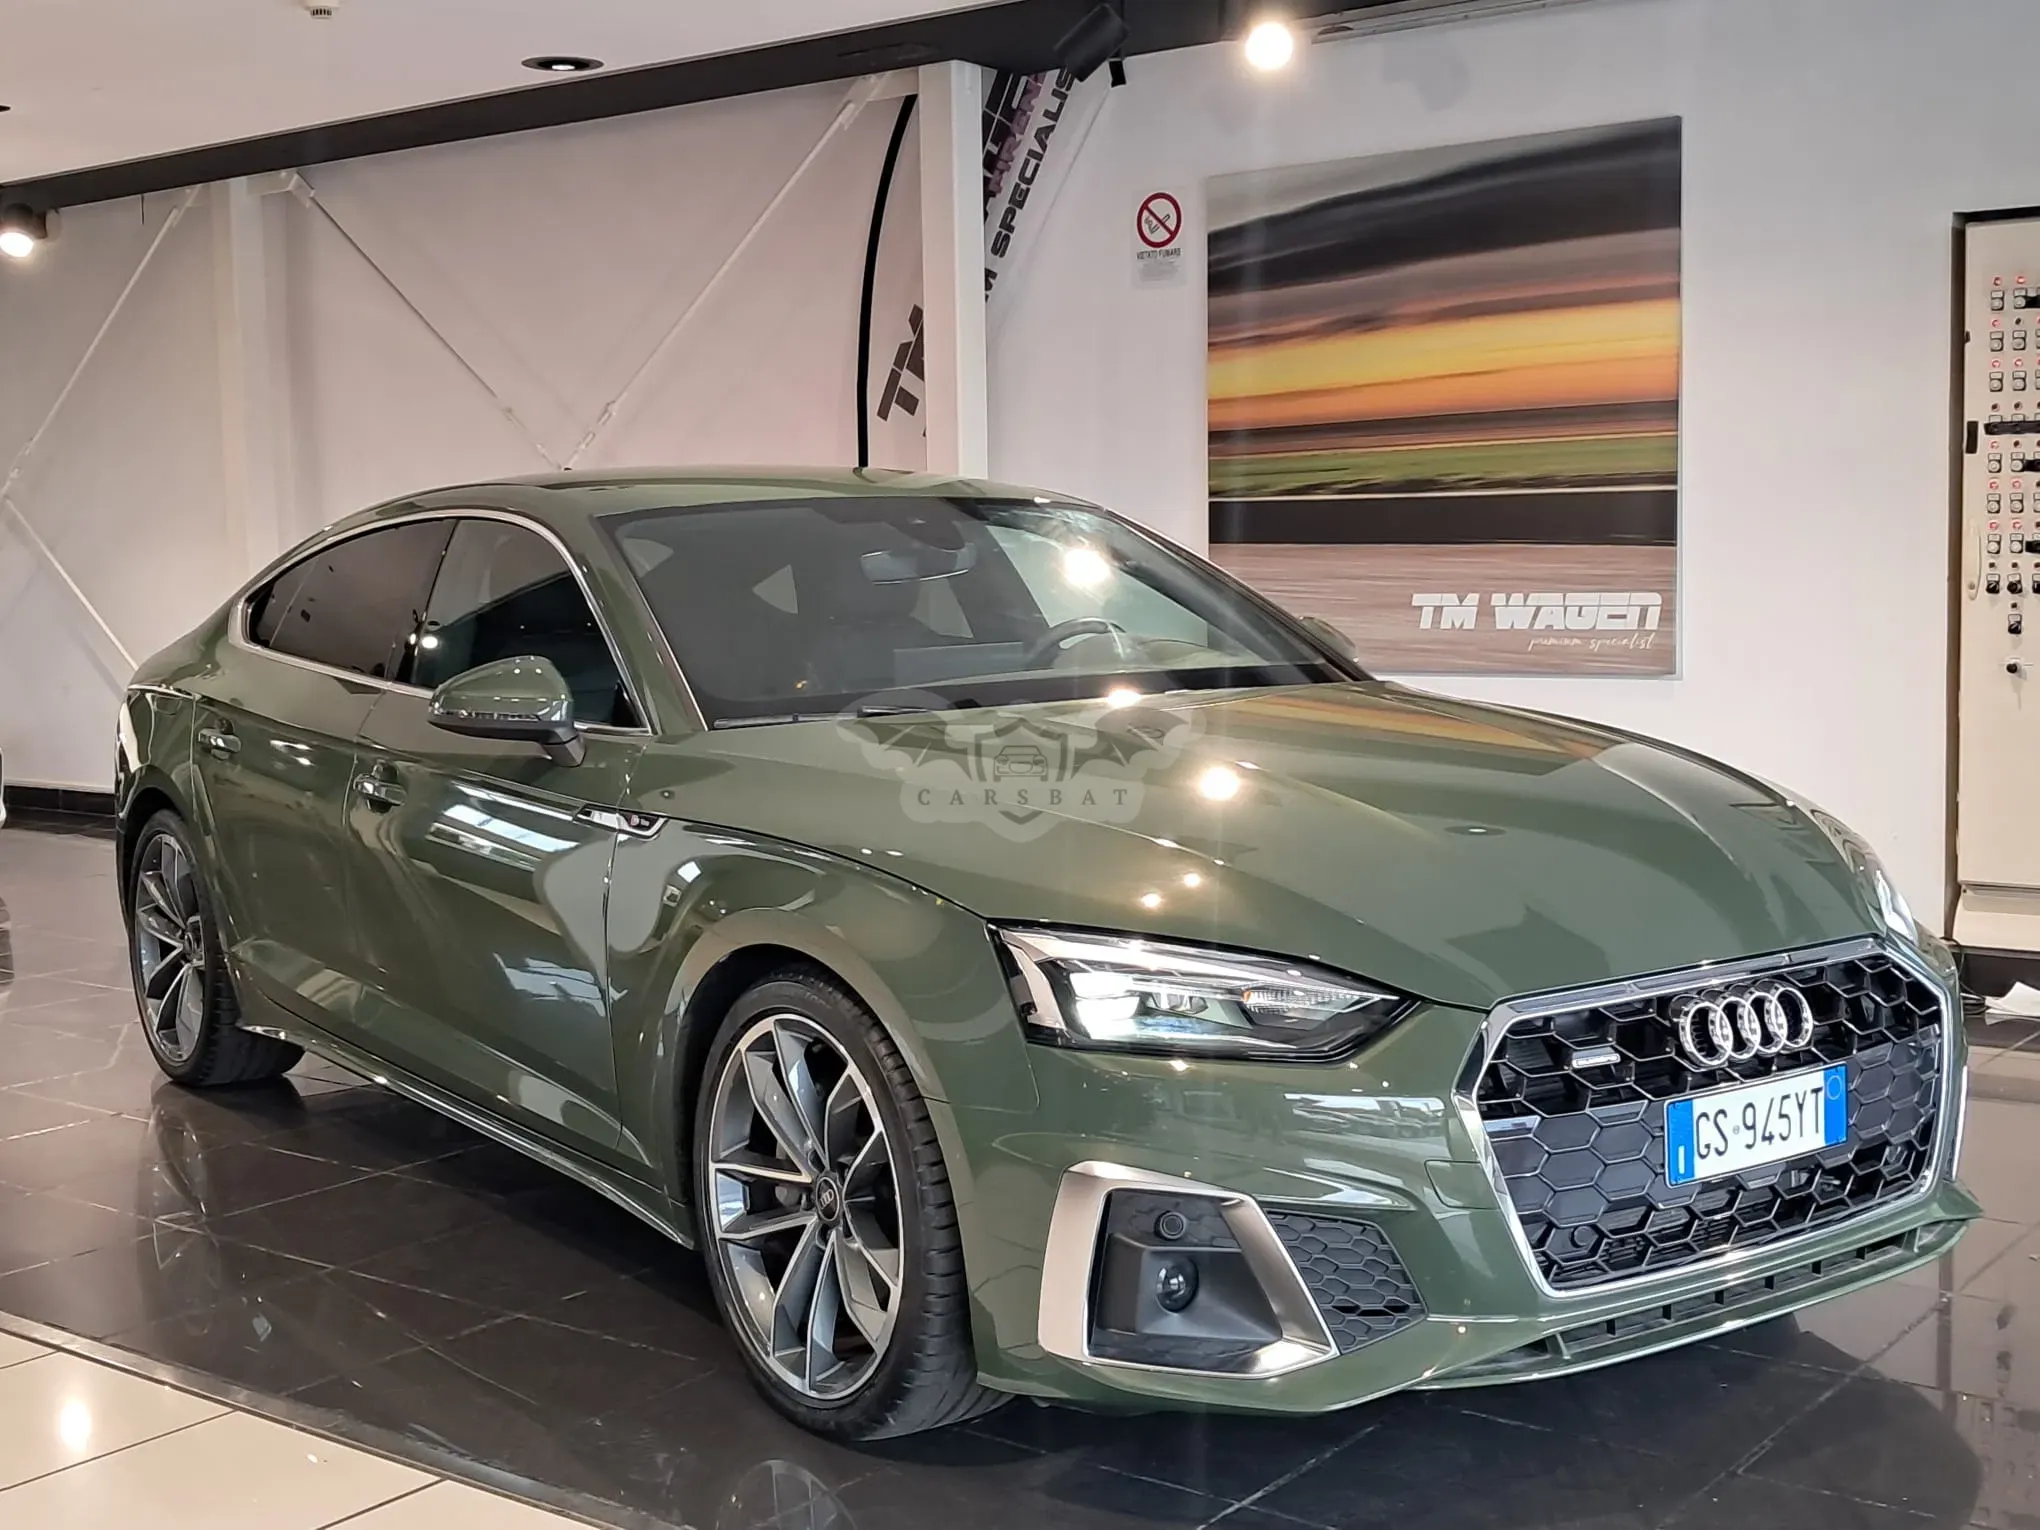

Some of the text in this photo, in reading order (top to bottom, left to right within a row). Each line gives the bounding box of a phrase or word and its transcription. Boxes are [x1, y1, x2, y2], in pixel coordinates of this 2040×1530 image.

[990, 68, 1076, 258] SPECIALIS
[1411, 593, 1480, 630] TM
[1589, 632, 1656, 652] specialist
